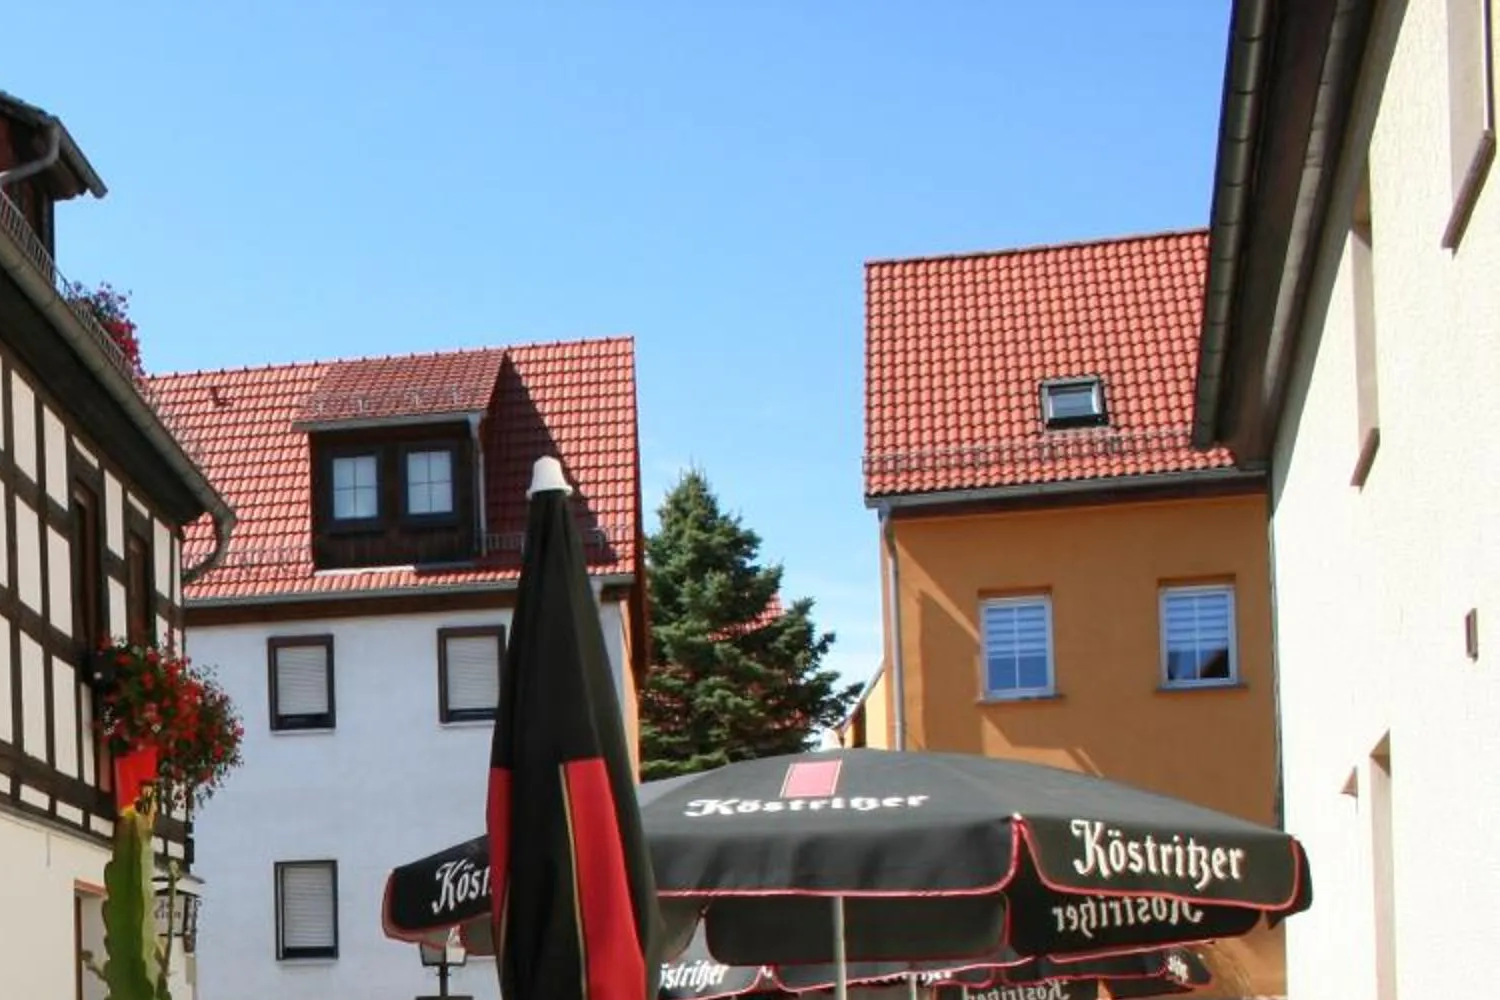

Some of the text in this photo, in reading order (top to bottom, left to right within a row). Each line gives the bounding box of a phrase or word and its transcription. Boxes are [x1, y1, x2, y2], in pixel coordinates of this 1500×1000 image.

[683, 795, 930, 817] Köstritzer
[1070, 818, 1244, 891] Köstritzer
[431, 858, 493, 915] Köst
